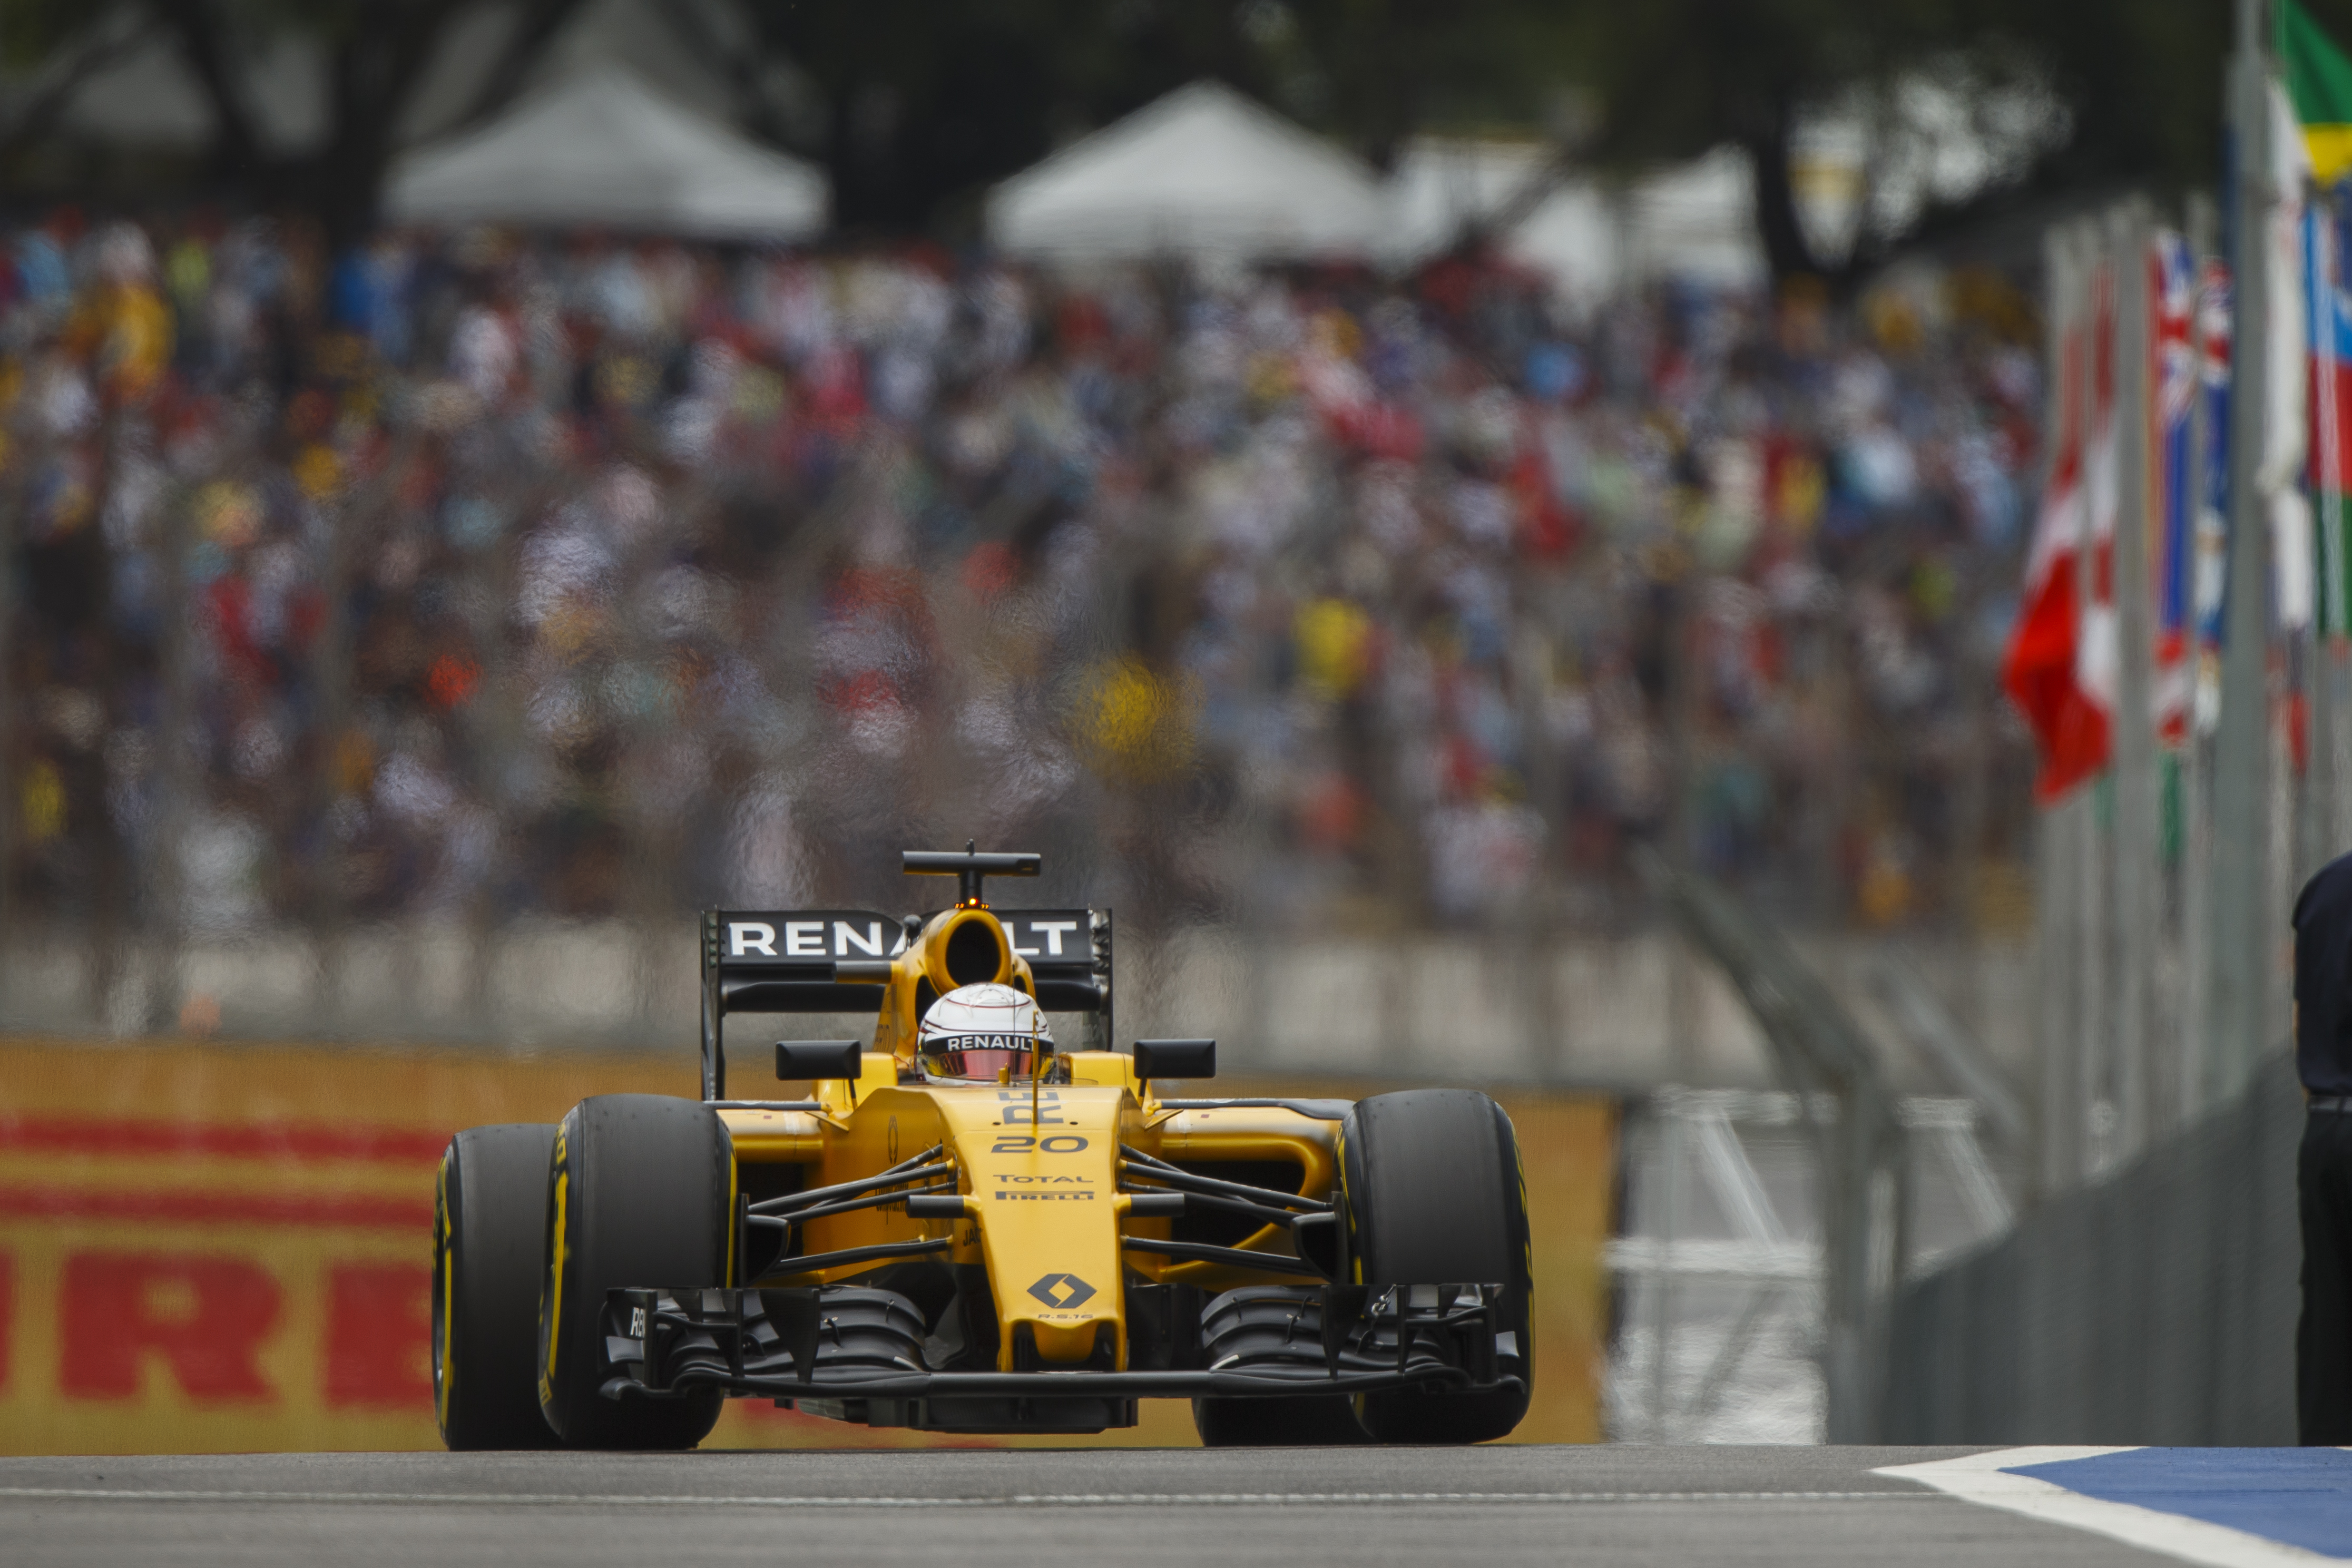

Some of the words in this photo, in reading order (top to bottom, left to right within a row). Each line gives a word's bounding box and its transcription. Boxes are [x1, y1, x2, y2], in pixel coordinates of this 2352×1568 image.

[729, 921, 1077, 956] RENLT
[948, 1035, 1034, 1052] RENAULT
[991, 1136, 1089, 1153] 20
[995, 1191, 1094, 1200] PIRELLI
